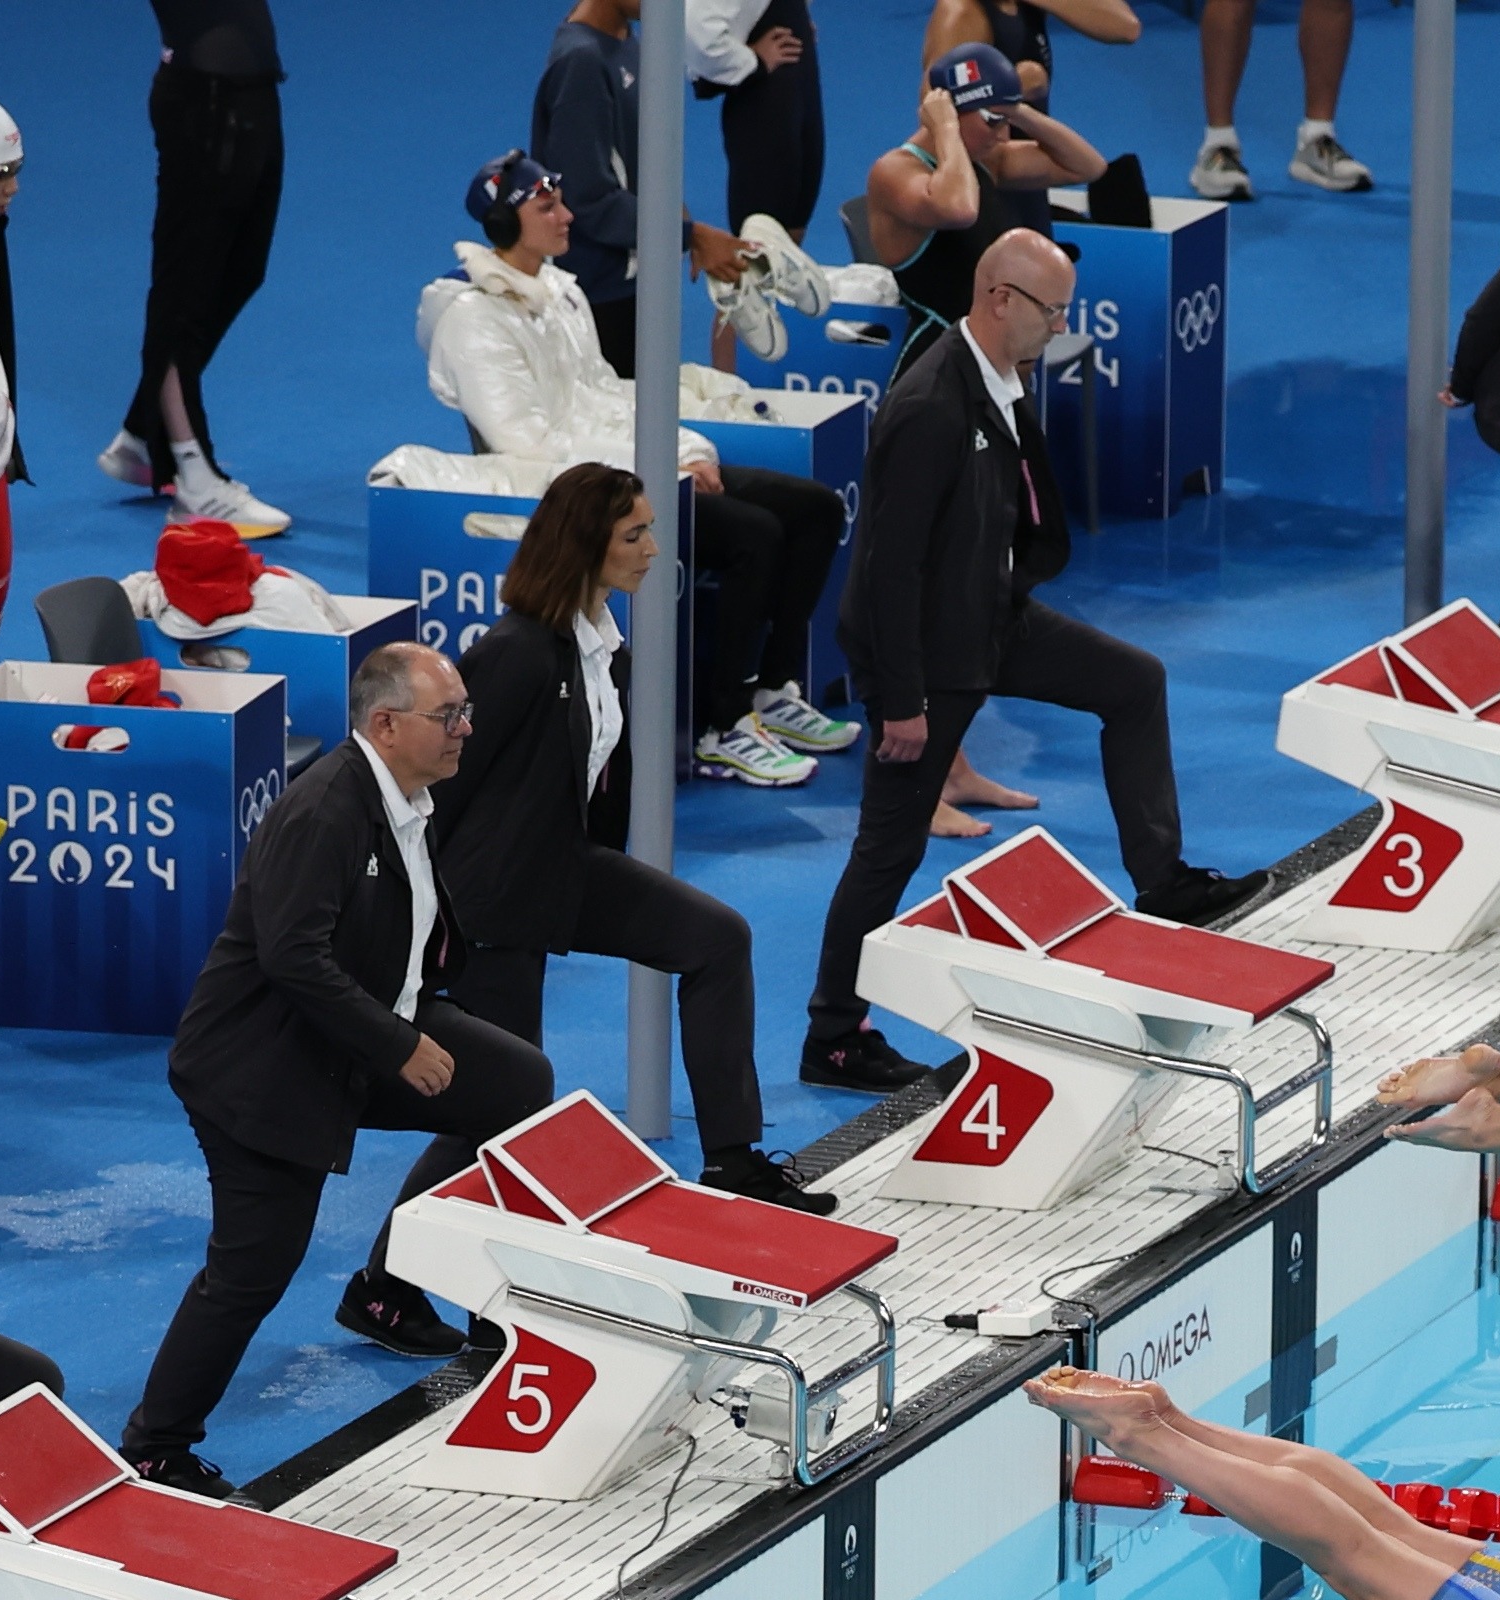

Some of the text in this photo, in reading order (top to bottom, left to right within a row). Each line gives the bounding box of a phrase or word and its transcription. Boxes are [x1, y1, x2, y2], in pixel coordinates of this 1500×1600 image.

[8, 838, 178, 892] 2024
[1382, 832, 1425, 898] 3
[960, 1083, 1006, 1151] 4
[753, 1286, 795, 1305] OMEGA
[1141, 1304, 1211, 1381] OMEGA
[506, 1362, 551, 1434] 5
